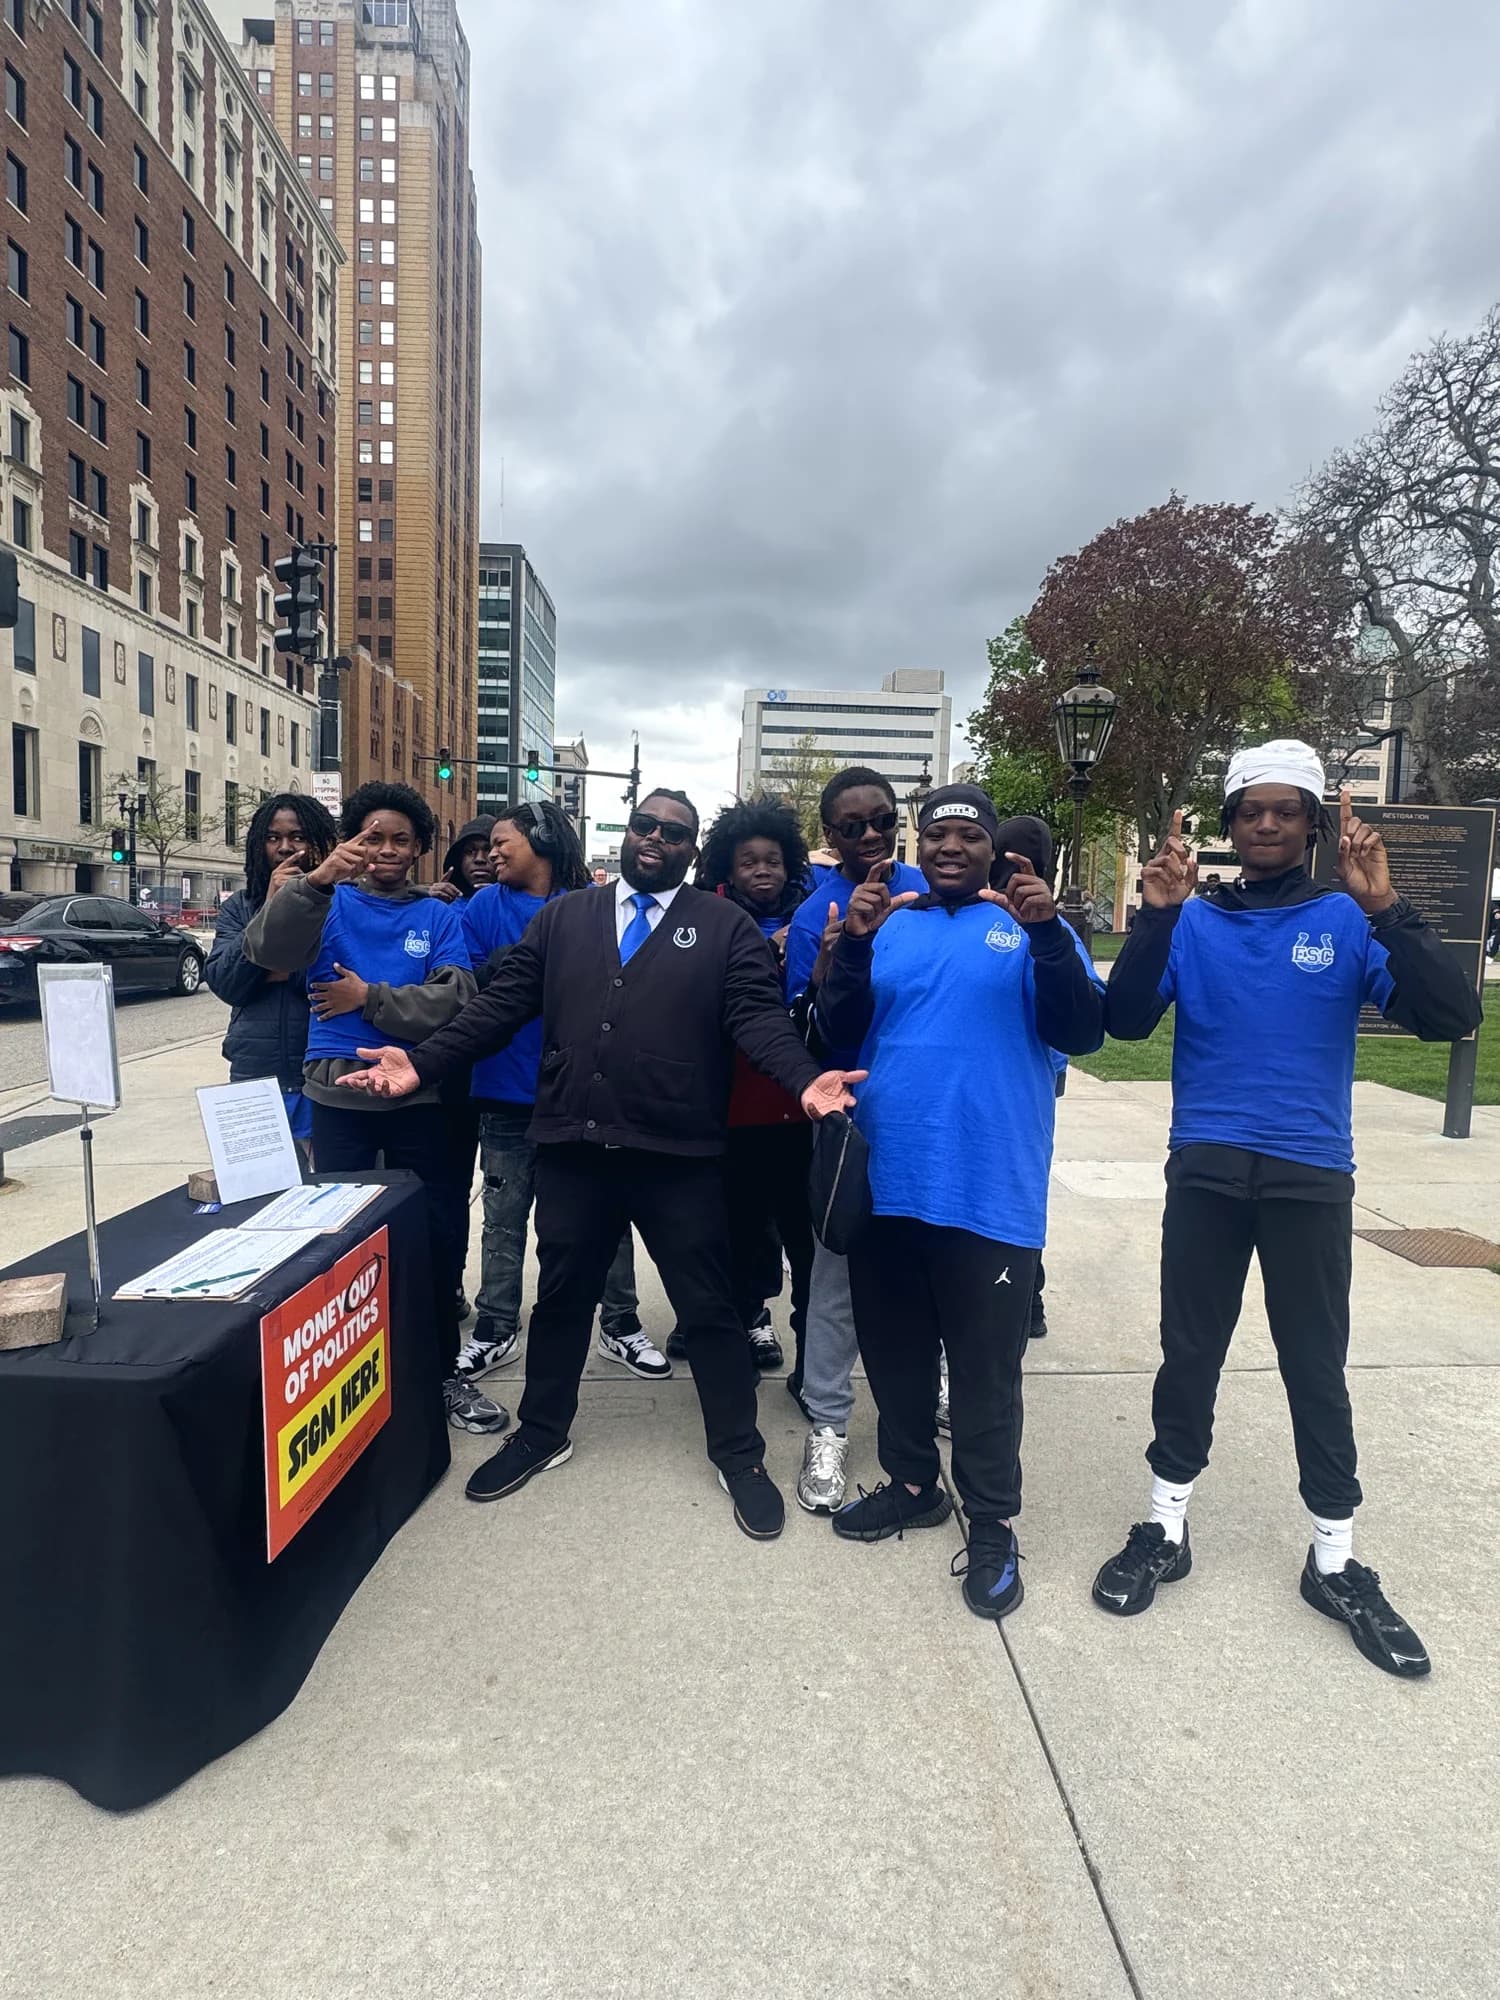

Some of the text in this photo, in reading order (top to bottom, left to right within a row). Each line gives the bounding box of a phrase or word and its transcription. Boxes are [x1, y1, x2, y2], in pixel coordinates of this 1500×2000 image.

[1382, 812, 1430, 820] RESTORATION
[985, 930, 1021, 948] ESC
[1291, 946, 1335, 965] ESC
[284, 1264, 378, 1369] MONEY OUT
[284, 1298, 379, 1404] OF POLITICS
[288, 1348, 380, 1483] SIGN HERE
